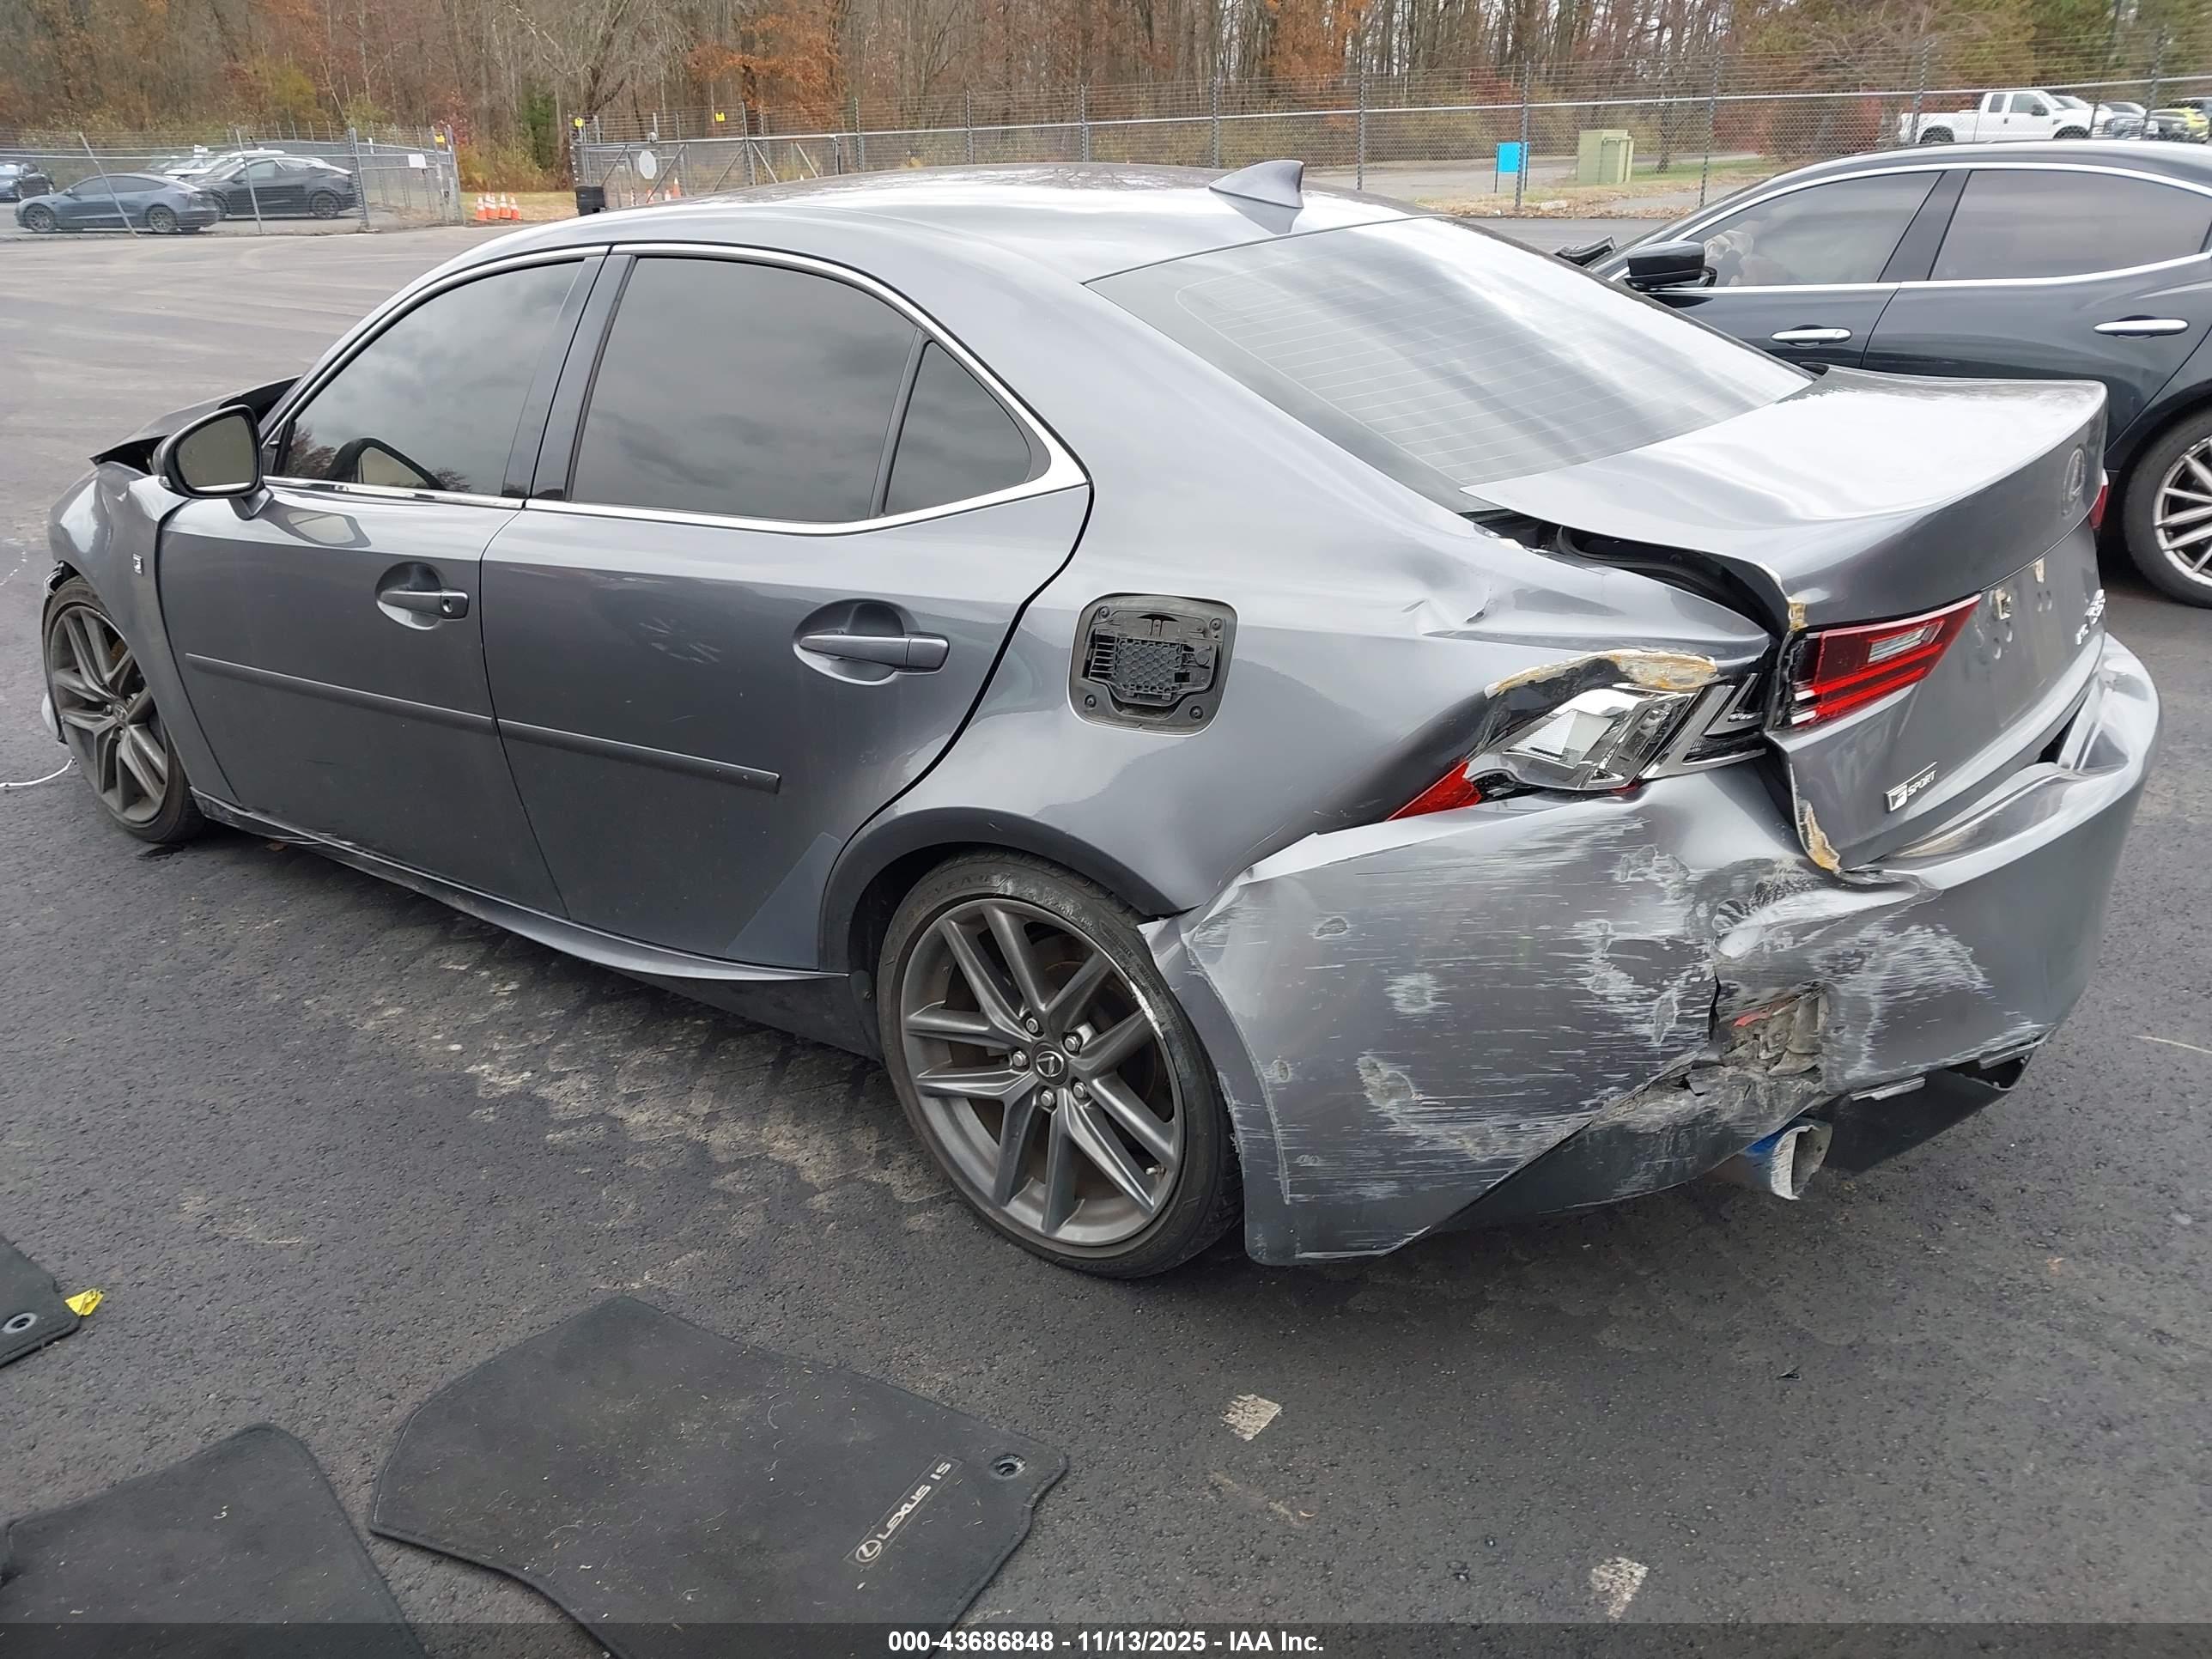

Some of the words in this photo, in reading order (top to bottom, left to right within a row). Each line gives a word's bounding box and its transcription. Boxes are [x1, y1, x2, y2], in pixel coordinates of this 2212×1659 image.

[1907, 769, 1938, 798] SPORT
[875, 1484, 933, 1540] LEXUS
[930, 1461, 952, 1481] IS
